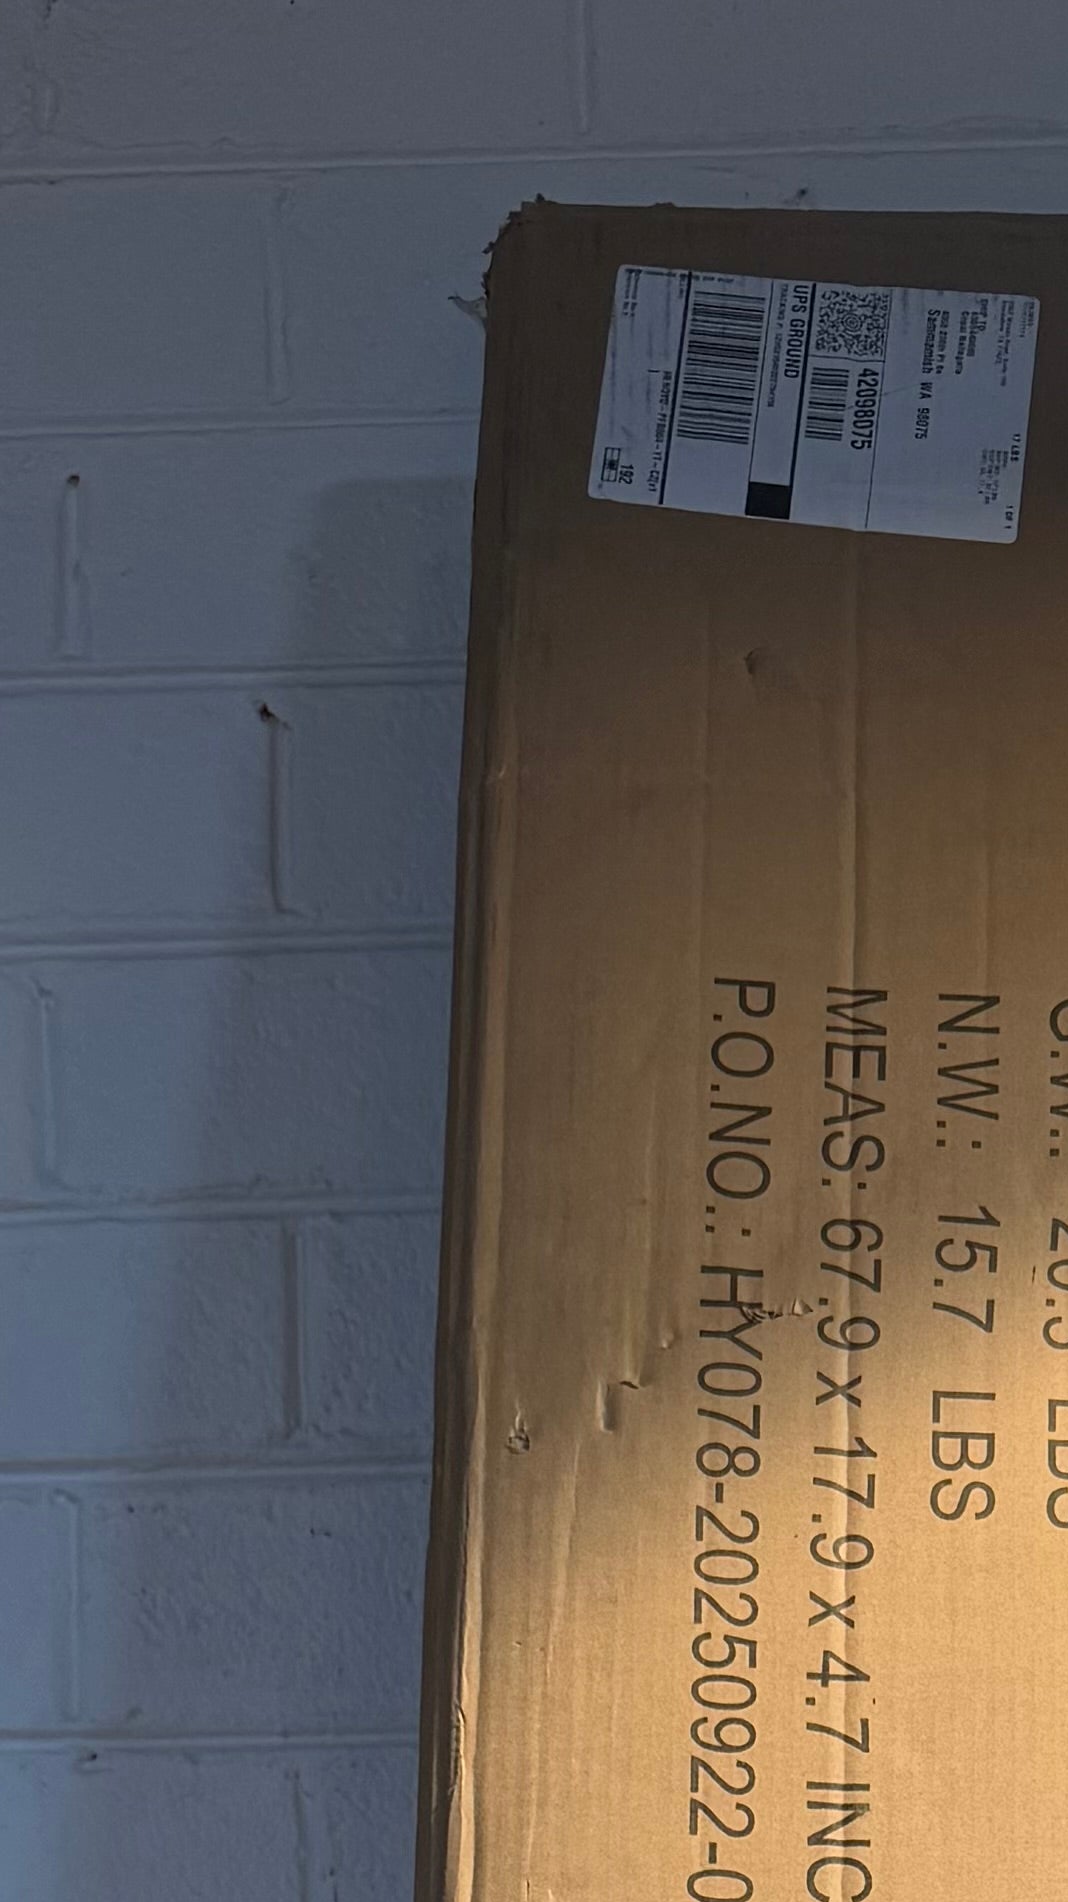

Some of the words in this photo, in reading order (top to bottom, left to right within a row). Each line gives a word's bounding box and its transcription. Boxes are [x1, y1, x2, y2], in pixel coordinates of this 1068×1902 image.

[791, 284, 809, 313] UPS
[782, 318, 805, 378] GROUND
[849, 367, 880, 450] 42098075
[914, 407, 930, 439] 98075
[918, 381, 932, 399] WA
[618, 463, 634, 484] 192
[1009, 444, 1020, 462] LBS
[705, 977, 776, 1239] P.O.NO.:
[821, 986, 888, 1192] MEAS:
[935, 993, 1000, 1151] N.W.:
[817, 1216, 884, 1354] 67.9
[933, 1203, 999, 1337] 15.7
[815, 1371, 862, 1409] x
[931, 1390, 997, 1523] LBS
[811, 1435, 875, 1573] 17.9
[809, 1590, 856, 1627] x
[806, 1650, 872, 1754] 4.7
